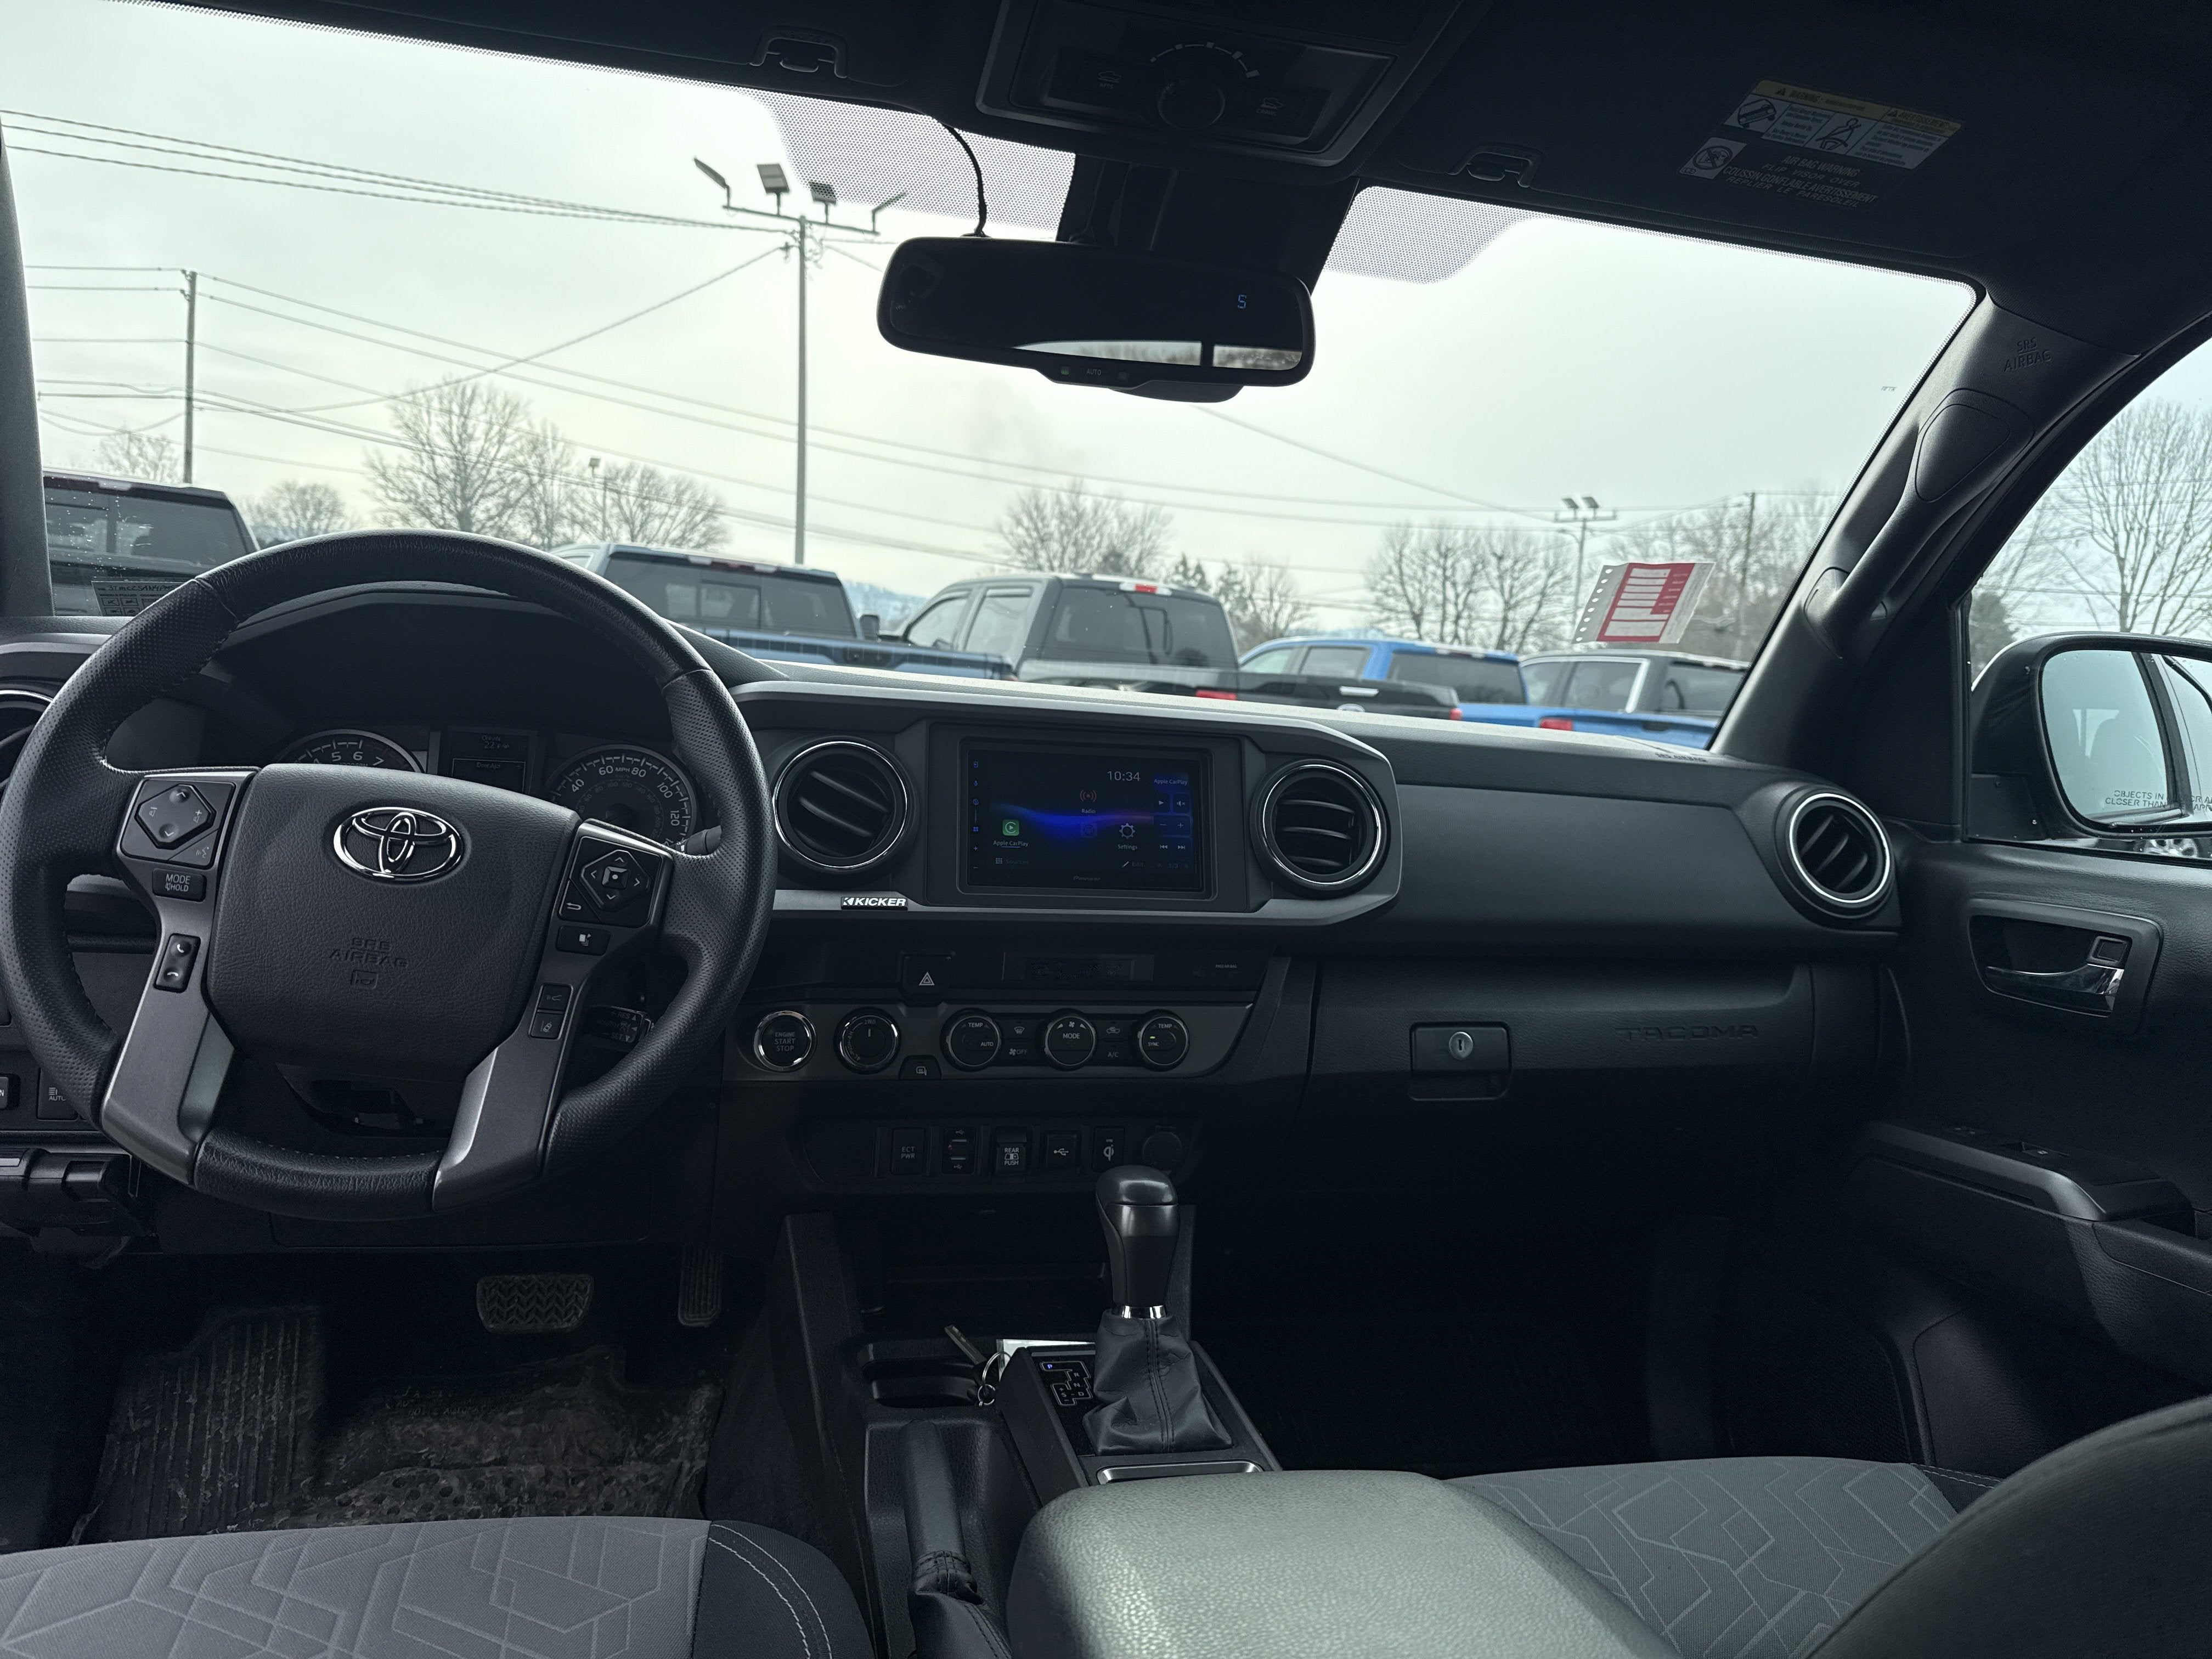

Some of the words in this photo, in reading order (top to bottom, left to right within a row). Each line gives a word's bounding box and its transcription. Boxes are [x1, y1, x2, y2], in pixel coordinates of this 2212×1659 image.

[1781, 156, 1799, 165] AIR
[1797, 158, 1819, 170] BAG
[1816, 162, 1861, 177] WARNING
[1762, 163, 1787, 172] FLIP
[1792, 169, 1825, 180] VISOR
[1830, 177, 1860, 187] OVER
[1723, 166, 1762, 180] COUSSIN
[1760, 173, 1812, 190] GONFLABLE
[1809, 183, 1878, 204] AVERTISSEMENT
[1726, 176, 1773, 190] REPLIER
[1776, 186, 1793, 194] LE
[1796, 190, 1860, 207] PARESOLEIL
[2017, 337, 2038, 352] SRS
[2003, 349, 2053, 373] AIRBAG
[331, 751, 342, 762] 5
[353, 751, 363, 761] 6
[372, 756, 385, 766] 7
[599, 765, 614, 776] 60
[631, 767, 647, 777] 80
[1107, 771, 1141, 782] 10:34
[571, 778, 585, 792] 40
[657, 782, 673, 799] 100
[2114, 790, 2153, 800] OBJECTS
[2105, 797, 2140, 806] CLOSER
[2143, 800, 2167, 809] THAN
[670, 810, 680, 826] 120
[166, 873, 191, 884] MODE
[171, 883, 189, 893] HOLD
[854, 897, 906, 906] KICKER
[352, 938, 392, 951] SRS
[329, 949, 409, 968] AIRBAG
[1615, 1024, 1758, 1041] TACOMA
